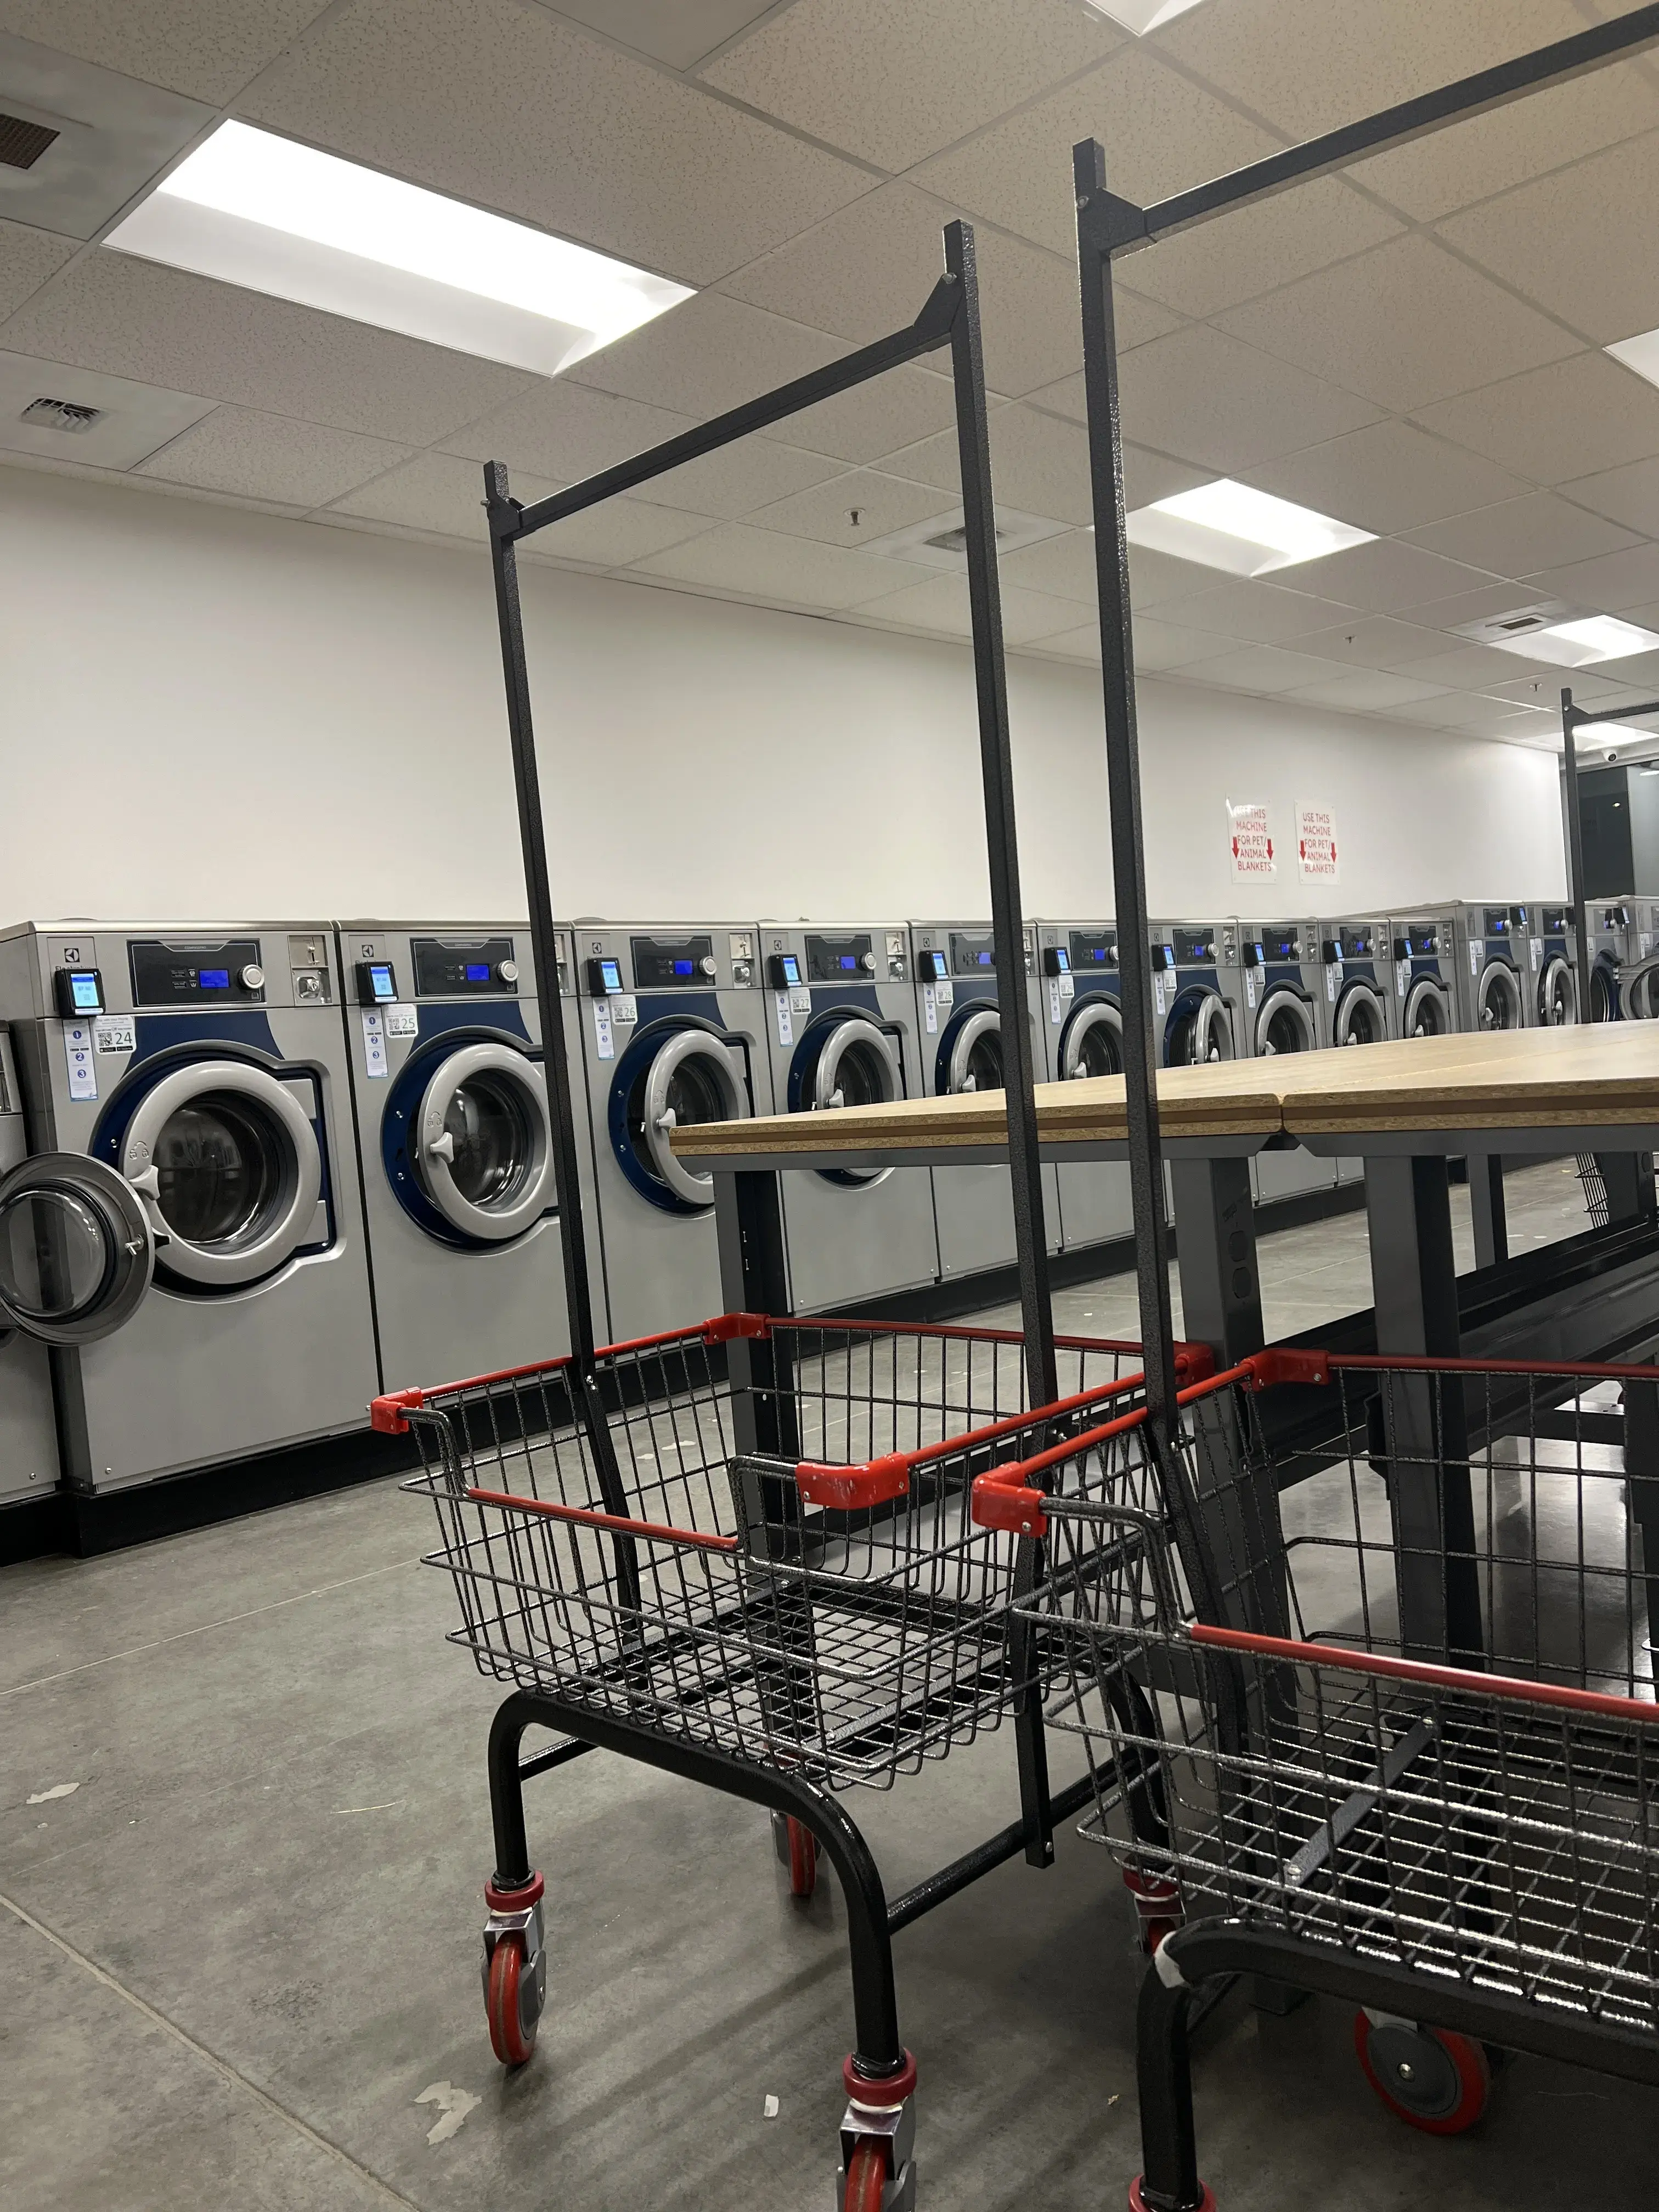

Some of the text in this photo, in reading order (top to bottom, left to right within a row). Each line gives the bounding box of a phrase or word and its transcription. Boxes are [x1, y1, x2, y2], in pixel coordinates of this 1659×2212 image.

[1250, 808, 1266, 819] THIS
[1302, 812, 1330, 823] USE THIS
[1236, 821, 1267, 831] MACHINE
[1303, 825, 1331, 836] MACHINE
[1237, 835, 1266, 847] FOR PET/
[1305, 839, 1330, 850] FOR PET/
[1240, 848, 1266, 859] ANIMAL
[1307, 851, 1330, 861] ANIMAL
[1238, 861, 1272, 871] BLANKETS
[1305, 863, 1335, 873] BLANKETS
[944, 991, 952, 1000] 28
[800, 998, 809, 1008] 27
[624, 1007, 635, 1017] 26
[401, 1018, 415, 1029] 25
[115, 1031, 133, 1045] 24
